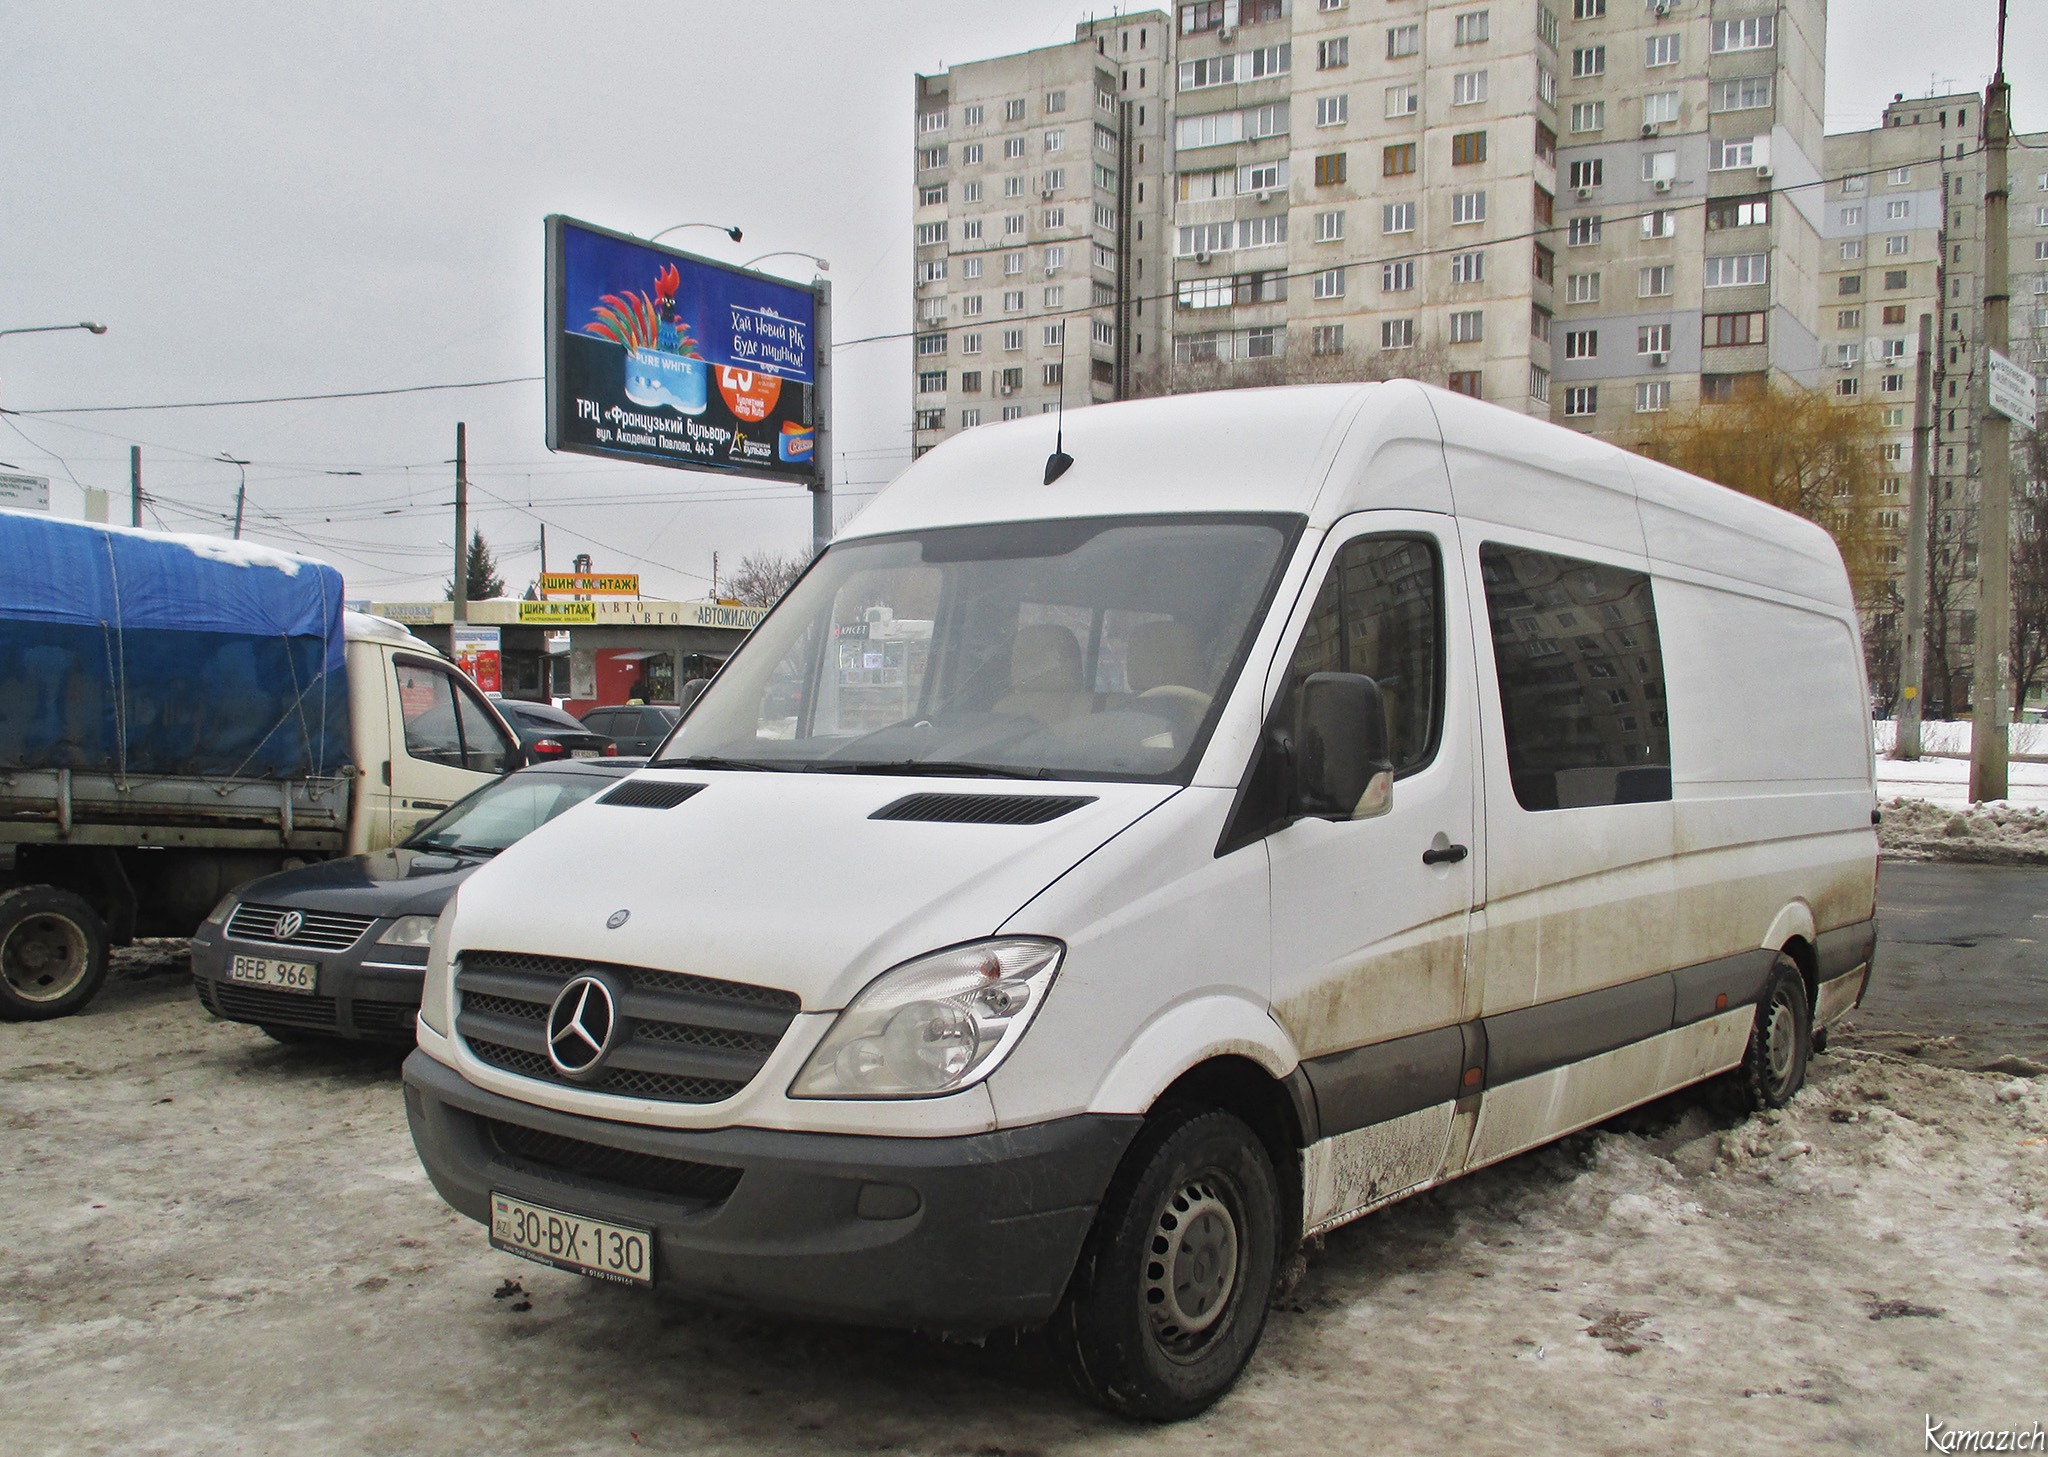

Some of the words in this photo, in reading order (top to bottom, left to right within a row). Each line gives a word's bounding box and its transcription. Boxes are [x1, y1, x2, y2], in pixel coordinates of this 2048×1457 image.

[731, 311, 752, 332] Хай
[755, 317, 786, 340] Новий
[734, 334, 758, 357] буде
[761, 342, 804, 367] пишним!
[661, 358, 693, 375] WHITE
[576, 398, 600, 423] ТРЦ
[604, 405, 684, 435] «Французький
[687, 418, 731, 445] бульвар»
[596, 427, 613, 442] вул.
[616, 428, 657, 447] Академіка
[547, 577, 631, 590] ШИНОМОНТАЖ
[524, 603, 590, 615] ШИНОМОНТАЖ
[600, 601, 644, 613] АВТО
[697, 605, 767, 627] АВТОЖИДКОС
[631, 613, 678, 624] АВТО
[235, 957, 267, 980] BEB
[277, 963, 308, 986] 966
